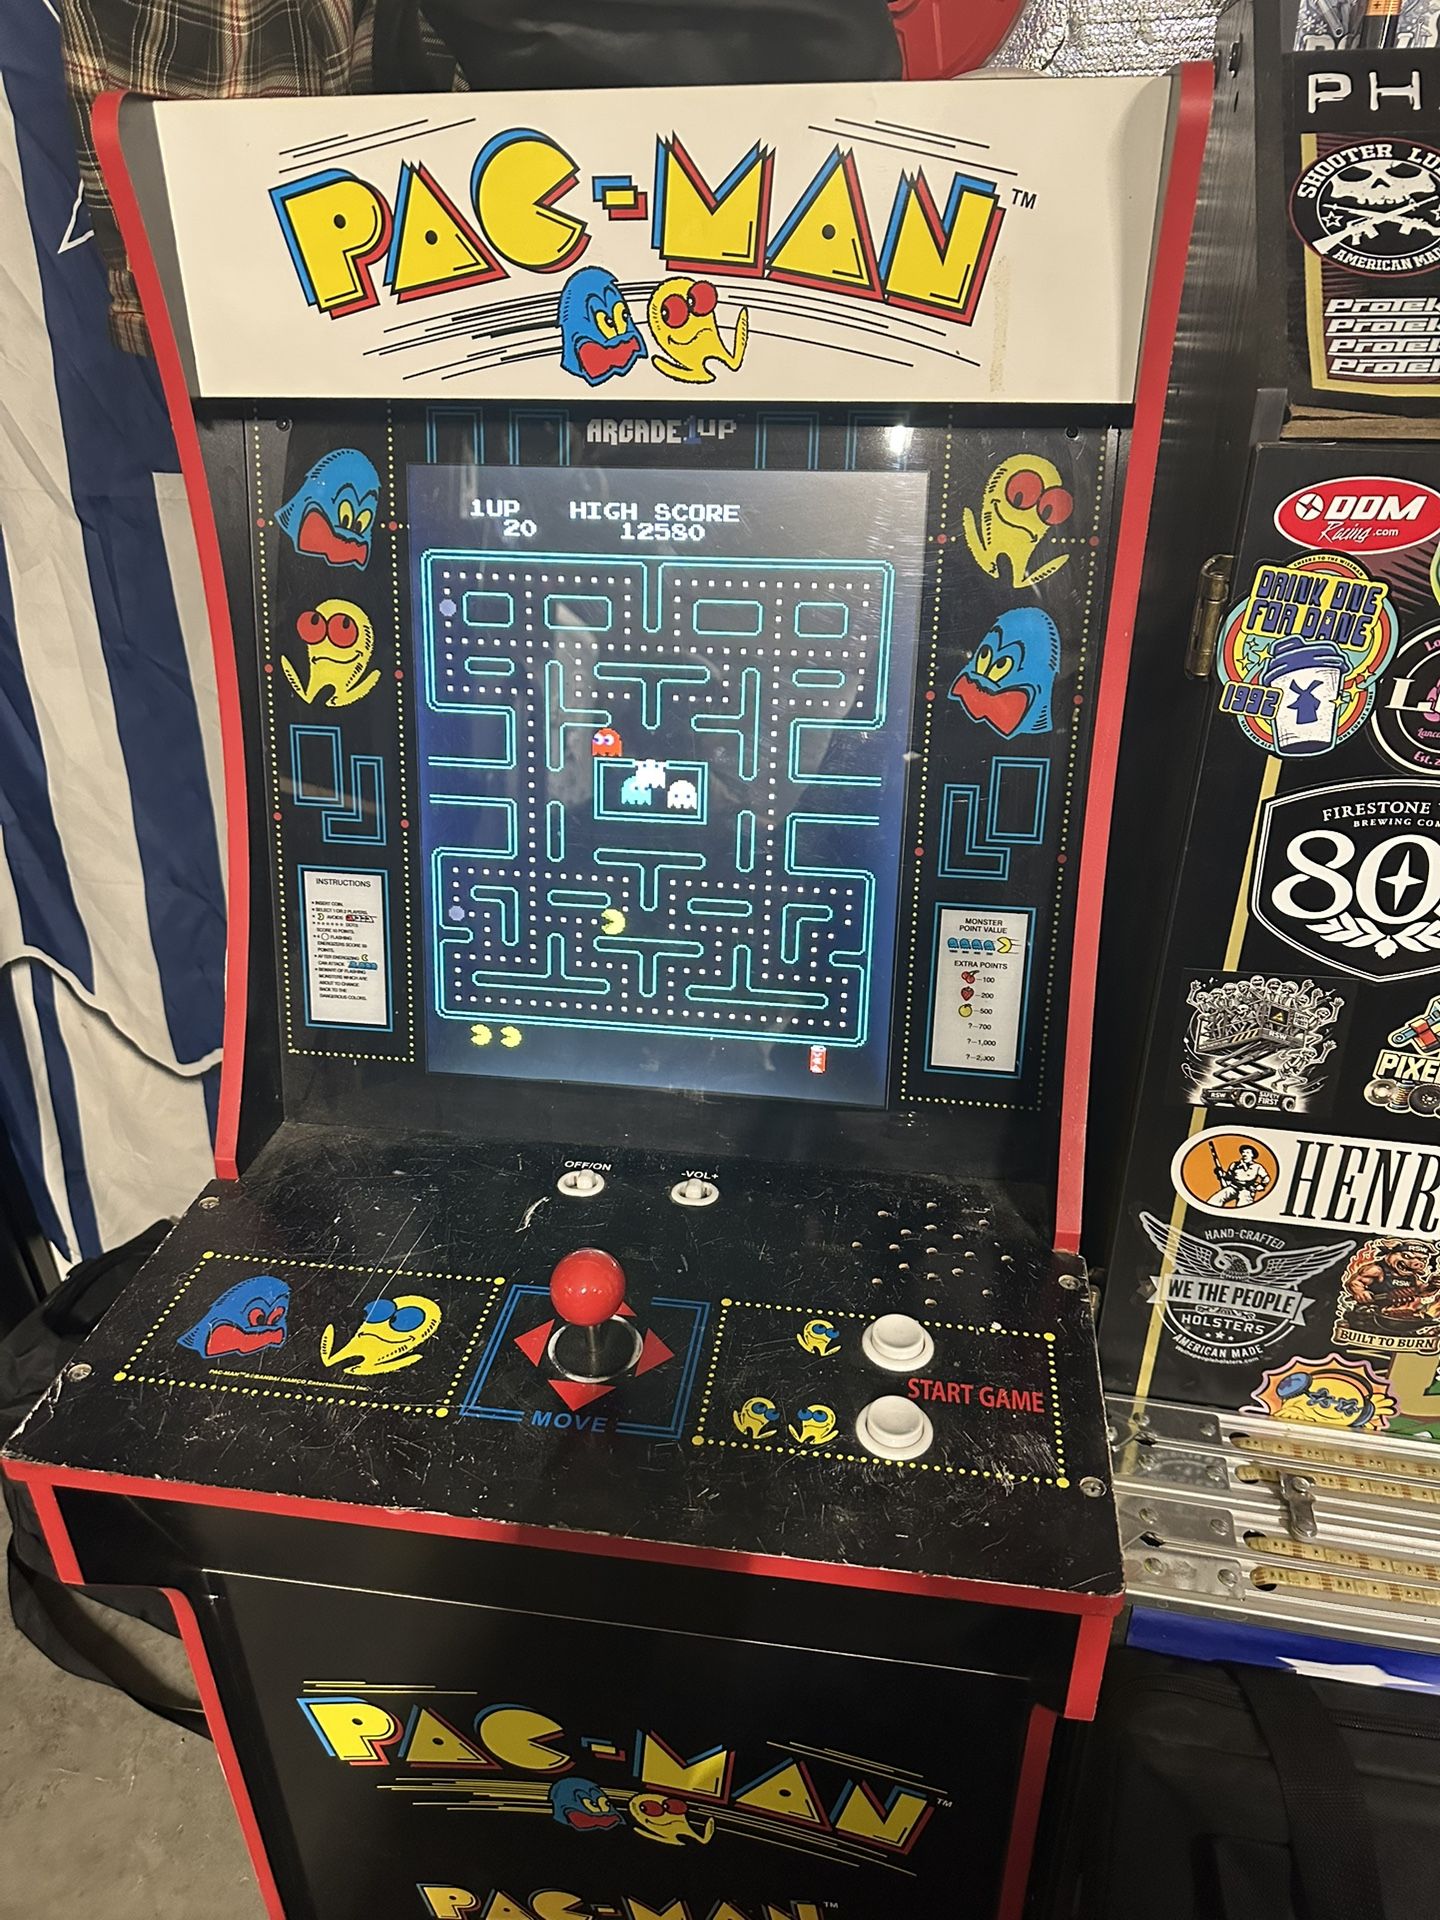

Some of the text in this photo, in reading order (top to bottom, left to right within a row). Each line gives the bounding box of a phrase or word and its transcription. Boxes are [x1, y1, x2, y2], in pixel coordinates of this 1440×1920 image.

[1297, 144, 1393, 199] SHOOTER
[268, 127, 1007, 325] PAC-MAN
[1332, 249, 1413, 272] AMERICAN
[470, 499, 520, 517] 1UP
[569, 501, 741, 523] HIGH SCORE
[503, 519, 537, 537] 20
[620, 522, 706, 541] 12580
[1318, 520, 1373, 544] Racing
[1256, 570, 1383, 615] DRINK ONE
[1247, 600, 1373, 647] FOR DANE
[1222, 683, 1280, 717] 1992
[1322, 801, 1432, 822] FIRESTONE
[1353, 817, 1412, 828] BREWING
[315, 878, 371, 887] INSTRUCTIONS
[965, 917, 1003, 926] MONSTER
[983, 926, 1008, 934] VALUE
[954, 960, 1008, 970] EXTRA POINTS
[1268, 1030, 1288, 1040] RSW
[1257, 1097, 1279, 1105] FIRST
[563, 1160, 612, 1172] OFF/ON
[1205, 1228, 1286, 1250] HAND-CRAFTED
[1408, 1245, 1429, 1253] RSW
[1168, 1279, 1296, 1315] WE THE PEOPLE
[1181, 1313, 1266, 1336] HOLSTERS
[1172, 1333, 1264, 1359] AMERICAN MADE
[1340, 1330, 1435, 1349] BUILT TO BURN
[907, 1377, 1046, 1414] START GAME
[530, 1410, 609, 1434] MOVE
[296, 1696, 935, 1856] PAC-MAN
